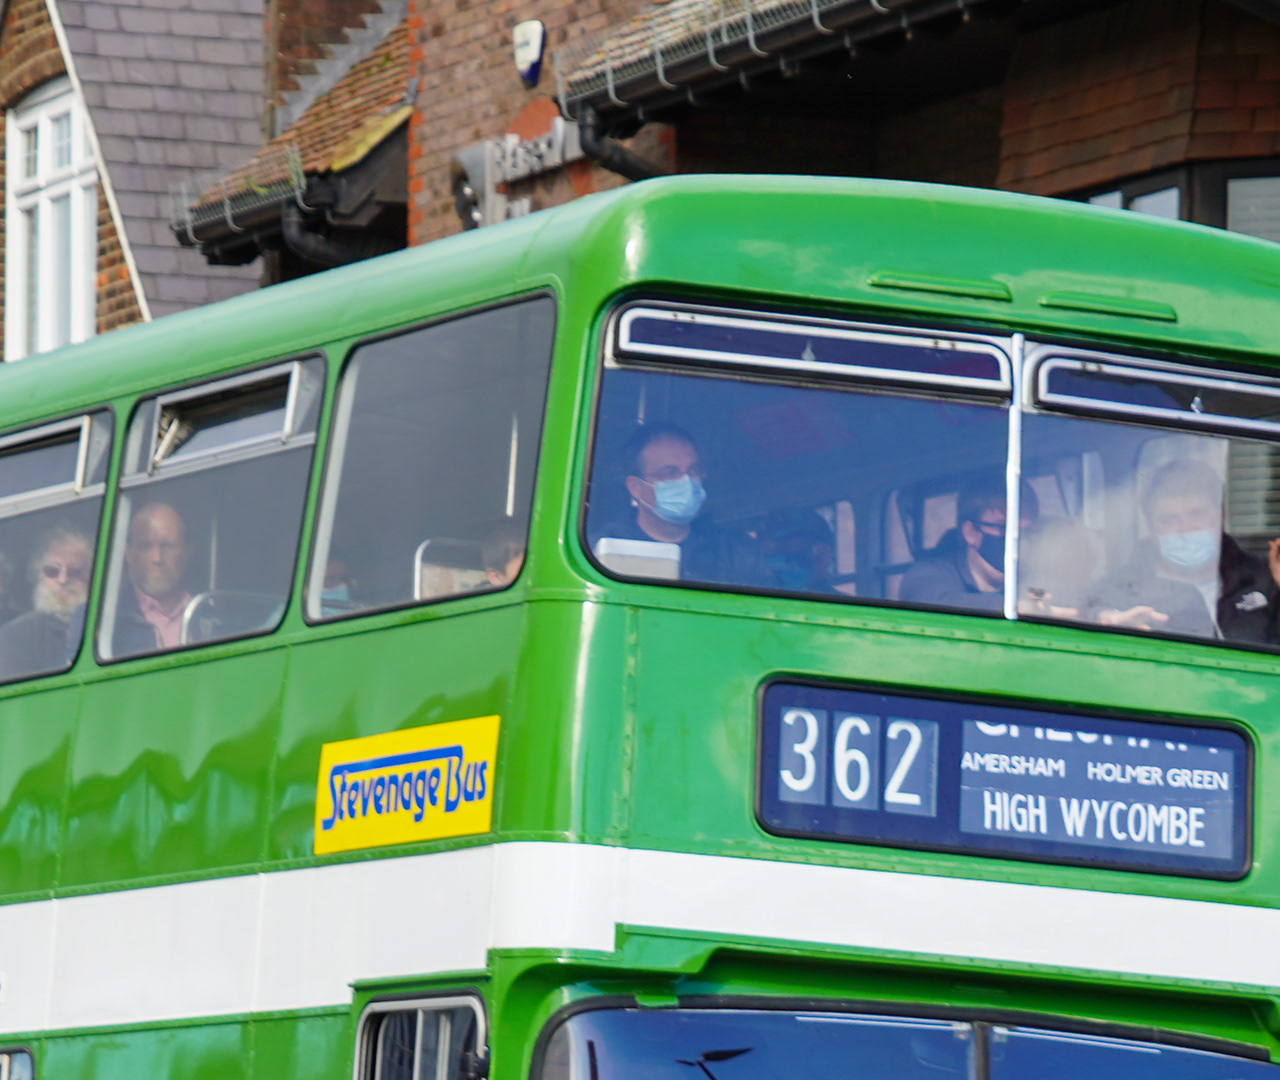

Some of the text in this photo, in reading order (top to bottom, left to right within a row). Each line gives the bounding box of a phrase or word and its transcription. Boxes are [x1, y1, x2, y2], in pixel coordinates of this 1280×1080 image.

[780, 709, 923, 806] 362
[960, 751, 1065, 778] AMERSHAM
[1087, 760, 1229, 791] HOLMER GREEN
[322, 745, 488, 831] Stevenage Bus
[983, 790, 1205, 847] HIGH WYCOMBE
